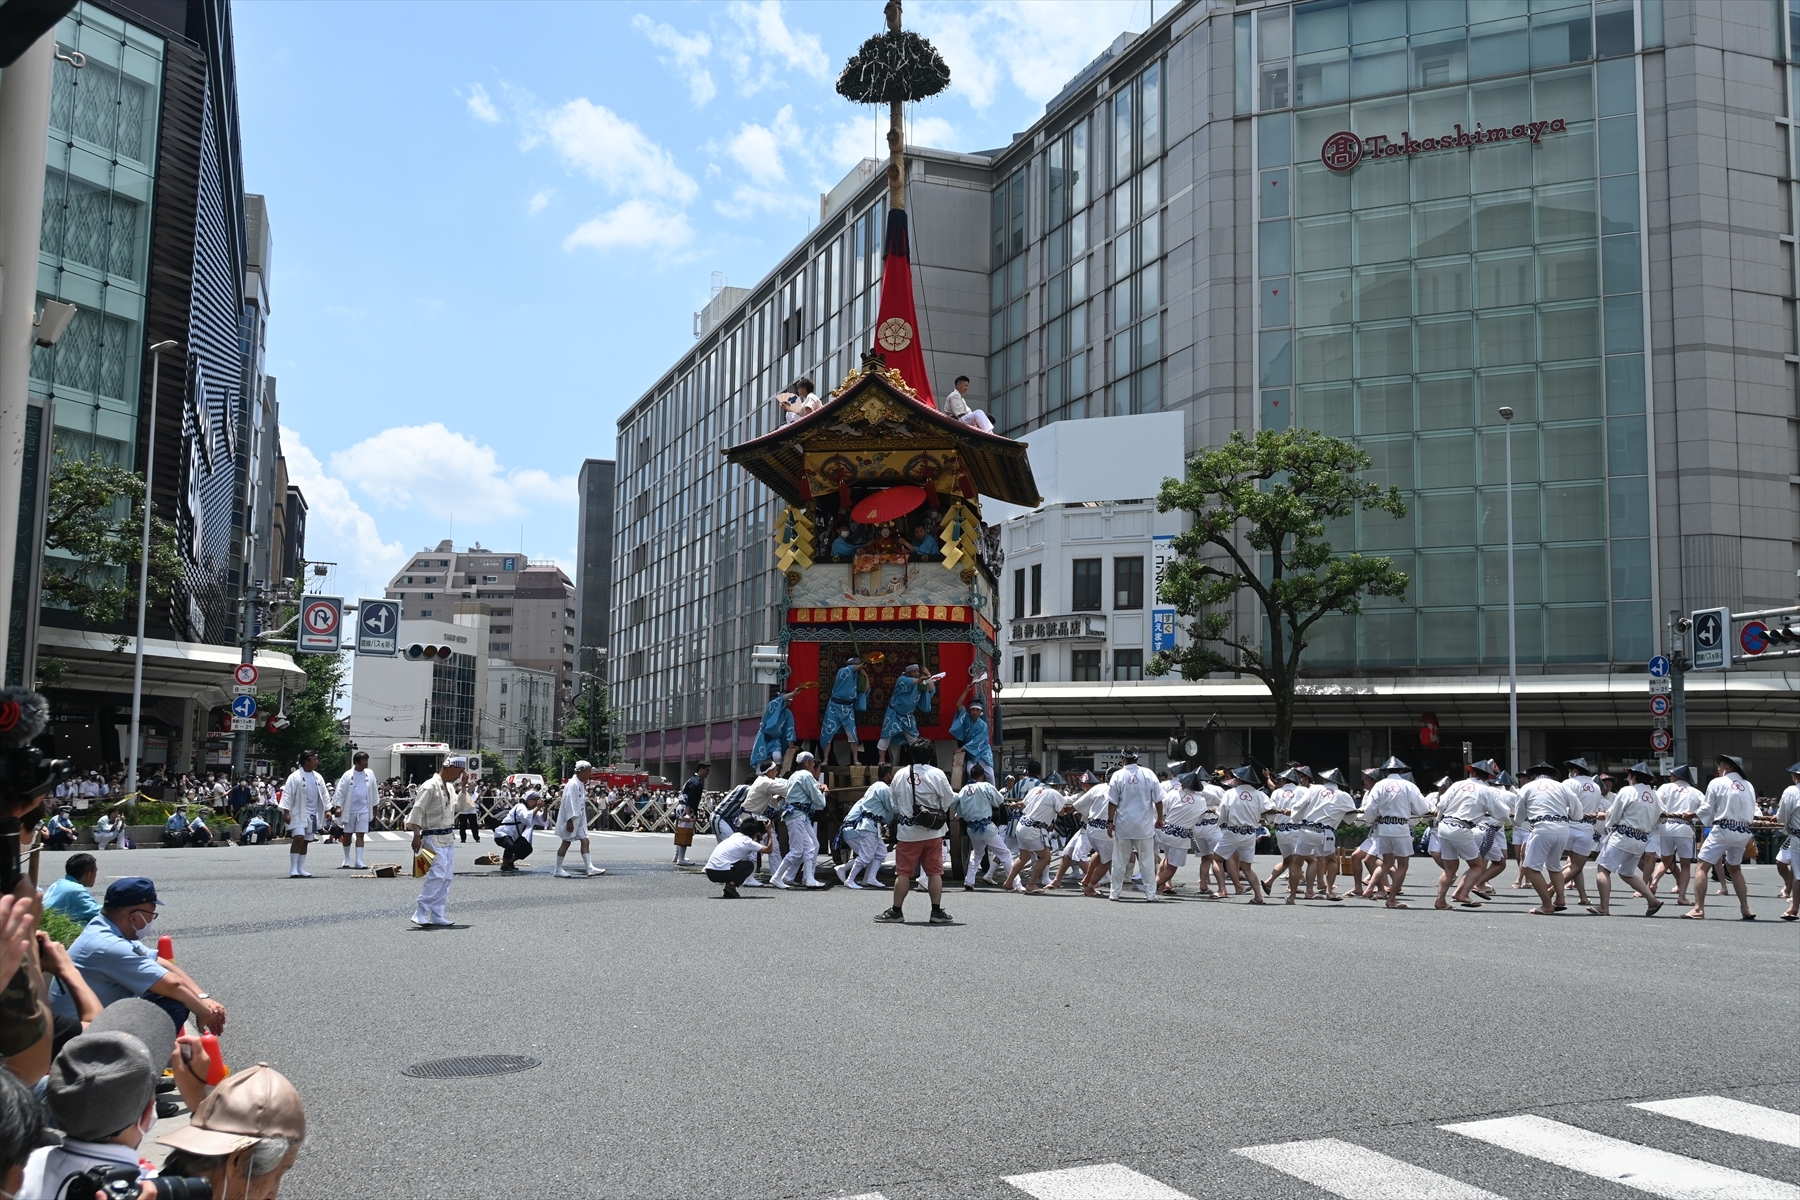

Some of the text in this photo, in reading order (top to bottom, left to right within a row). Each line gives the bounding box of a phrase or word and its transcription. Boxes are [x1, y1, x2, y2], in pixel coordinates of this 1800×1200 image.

[1364, 117, 1568, 160] Takashimaya
[1154, 613, 1163, 651] 買えます
[1164, 614, 1173, 634] すぐ
